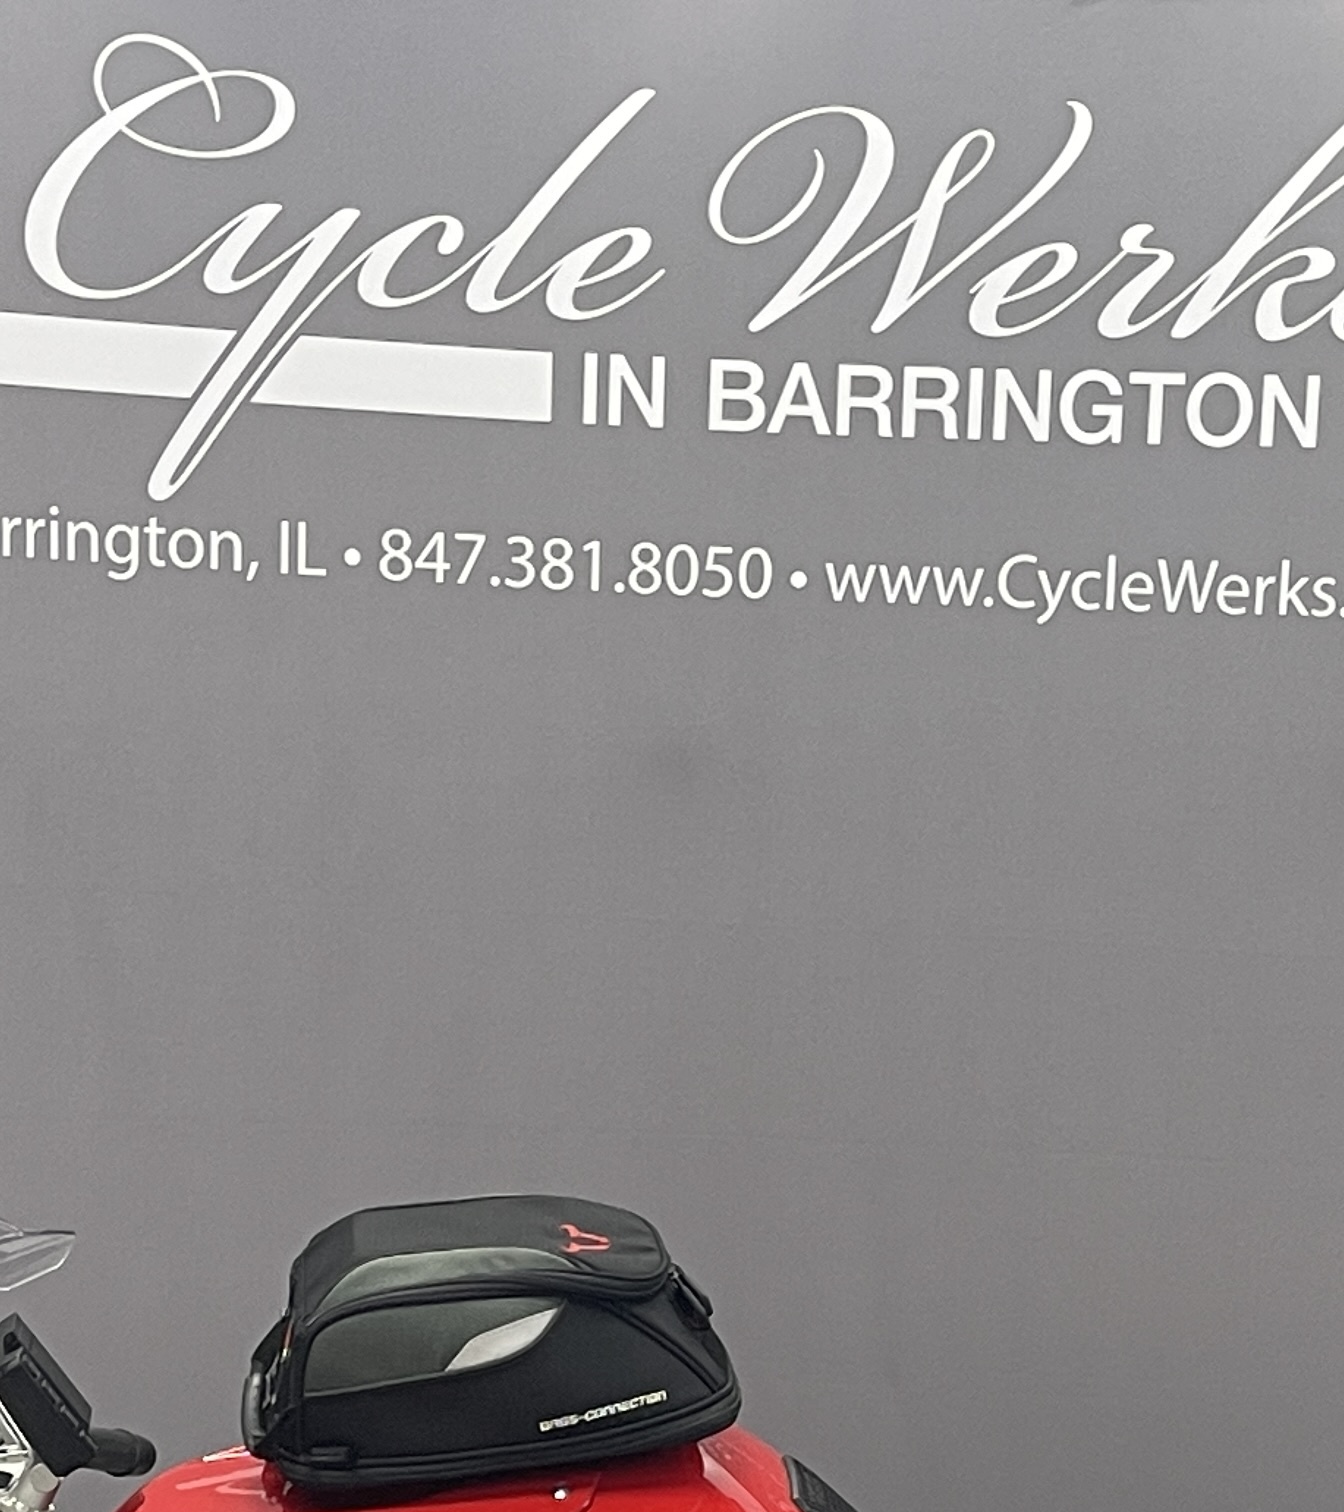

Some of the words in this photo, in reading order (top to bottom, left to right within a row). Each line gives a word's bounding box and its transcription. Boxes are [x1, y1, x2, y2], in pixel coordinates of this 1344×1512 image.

[23, 33, 666, 501] Cycle
[582, 352, 666, 429] IN
[708, 358, 1321, 448] BARRINGTON
[279, 520, 327, 577] IL
[378, 528, 774, 600] 847.381.8050
